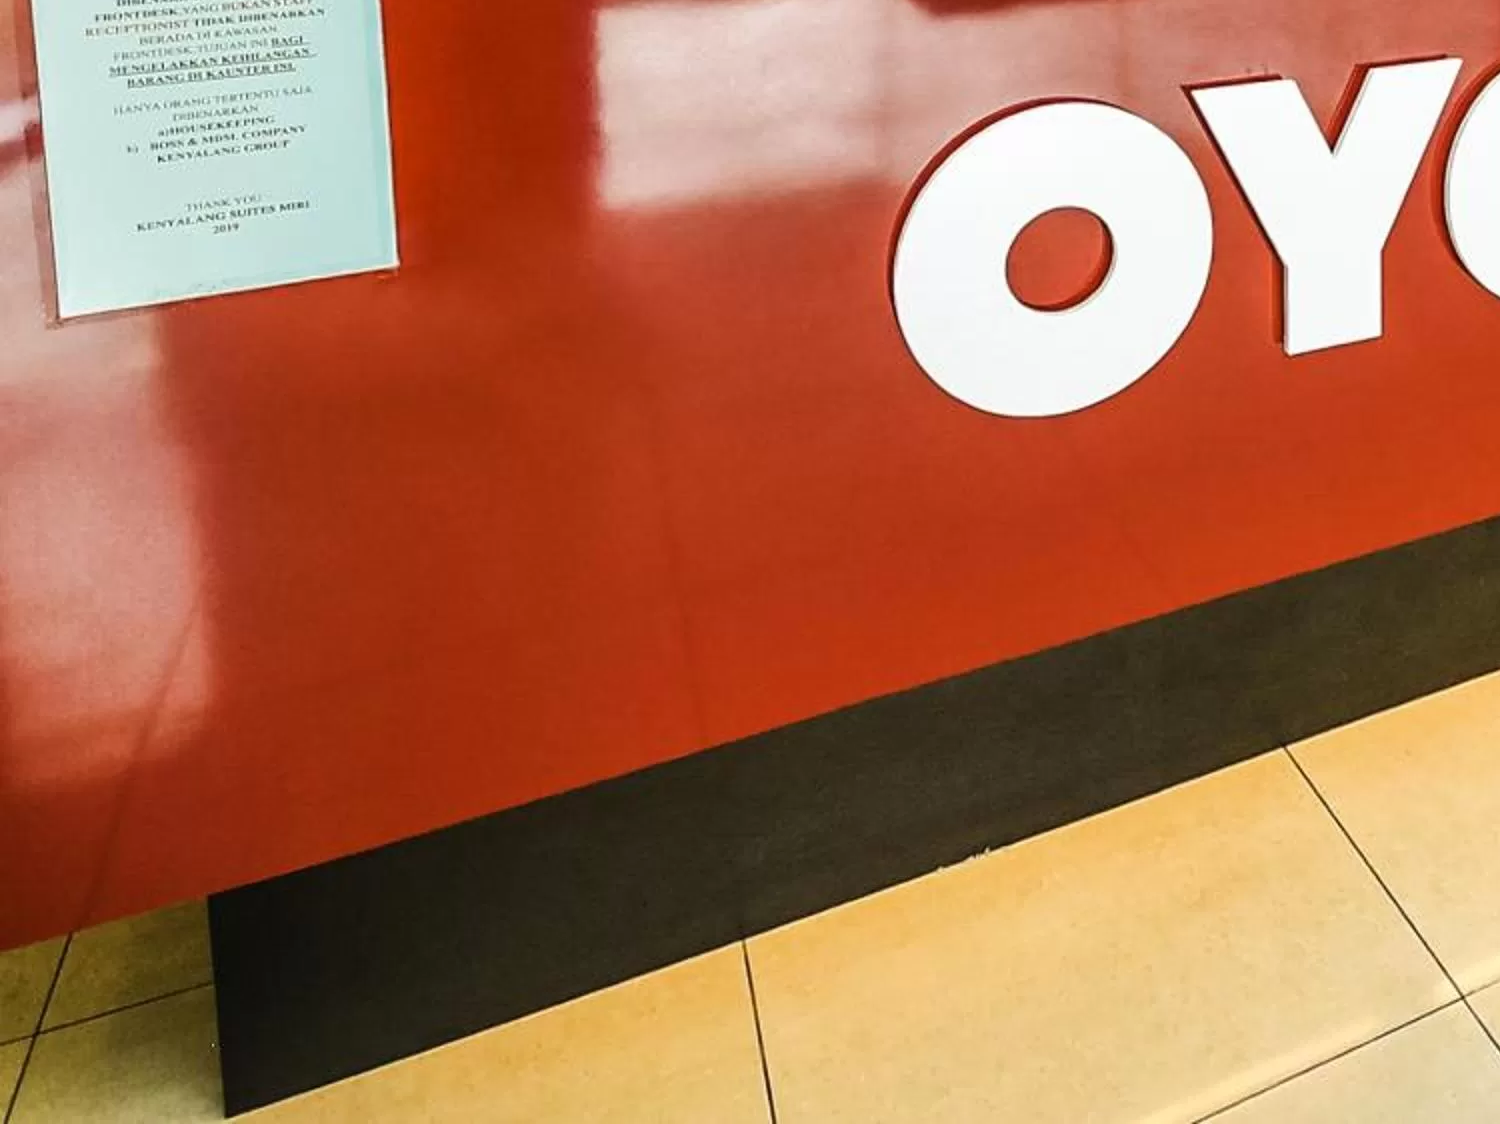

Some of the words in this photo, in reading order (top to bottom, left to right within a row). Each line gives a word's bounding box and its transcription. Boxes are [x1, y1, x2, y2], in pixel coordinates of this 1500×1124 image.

[85, 19, 188, 37] RECEPTIONIST
[214, 25, 277, 38] KAWASAN
[113, 101, 161, 116] HANYA
[173, 105, 258, 122] DIBENARKAN
[242, 125, 305, 140] COMPANY
[157, 146, 241, 164] KENYALANG
[244, 139, 291, 153] GROUP
[186, 199, 231, 212] THANK
[234, 194, 262, 206] YOU
[137, 212, 226, 232] KENYALANG
[229, 205, 276, 219] SUITES
[279, 200, 310, 212] MIRI
[212, 222, 240, 235] 2019
